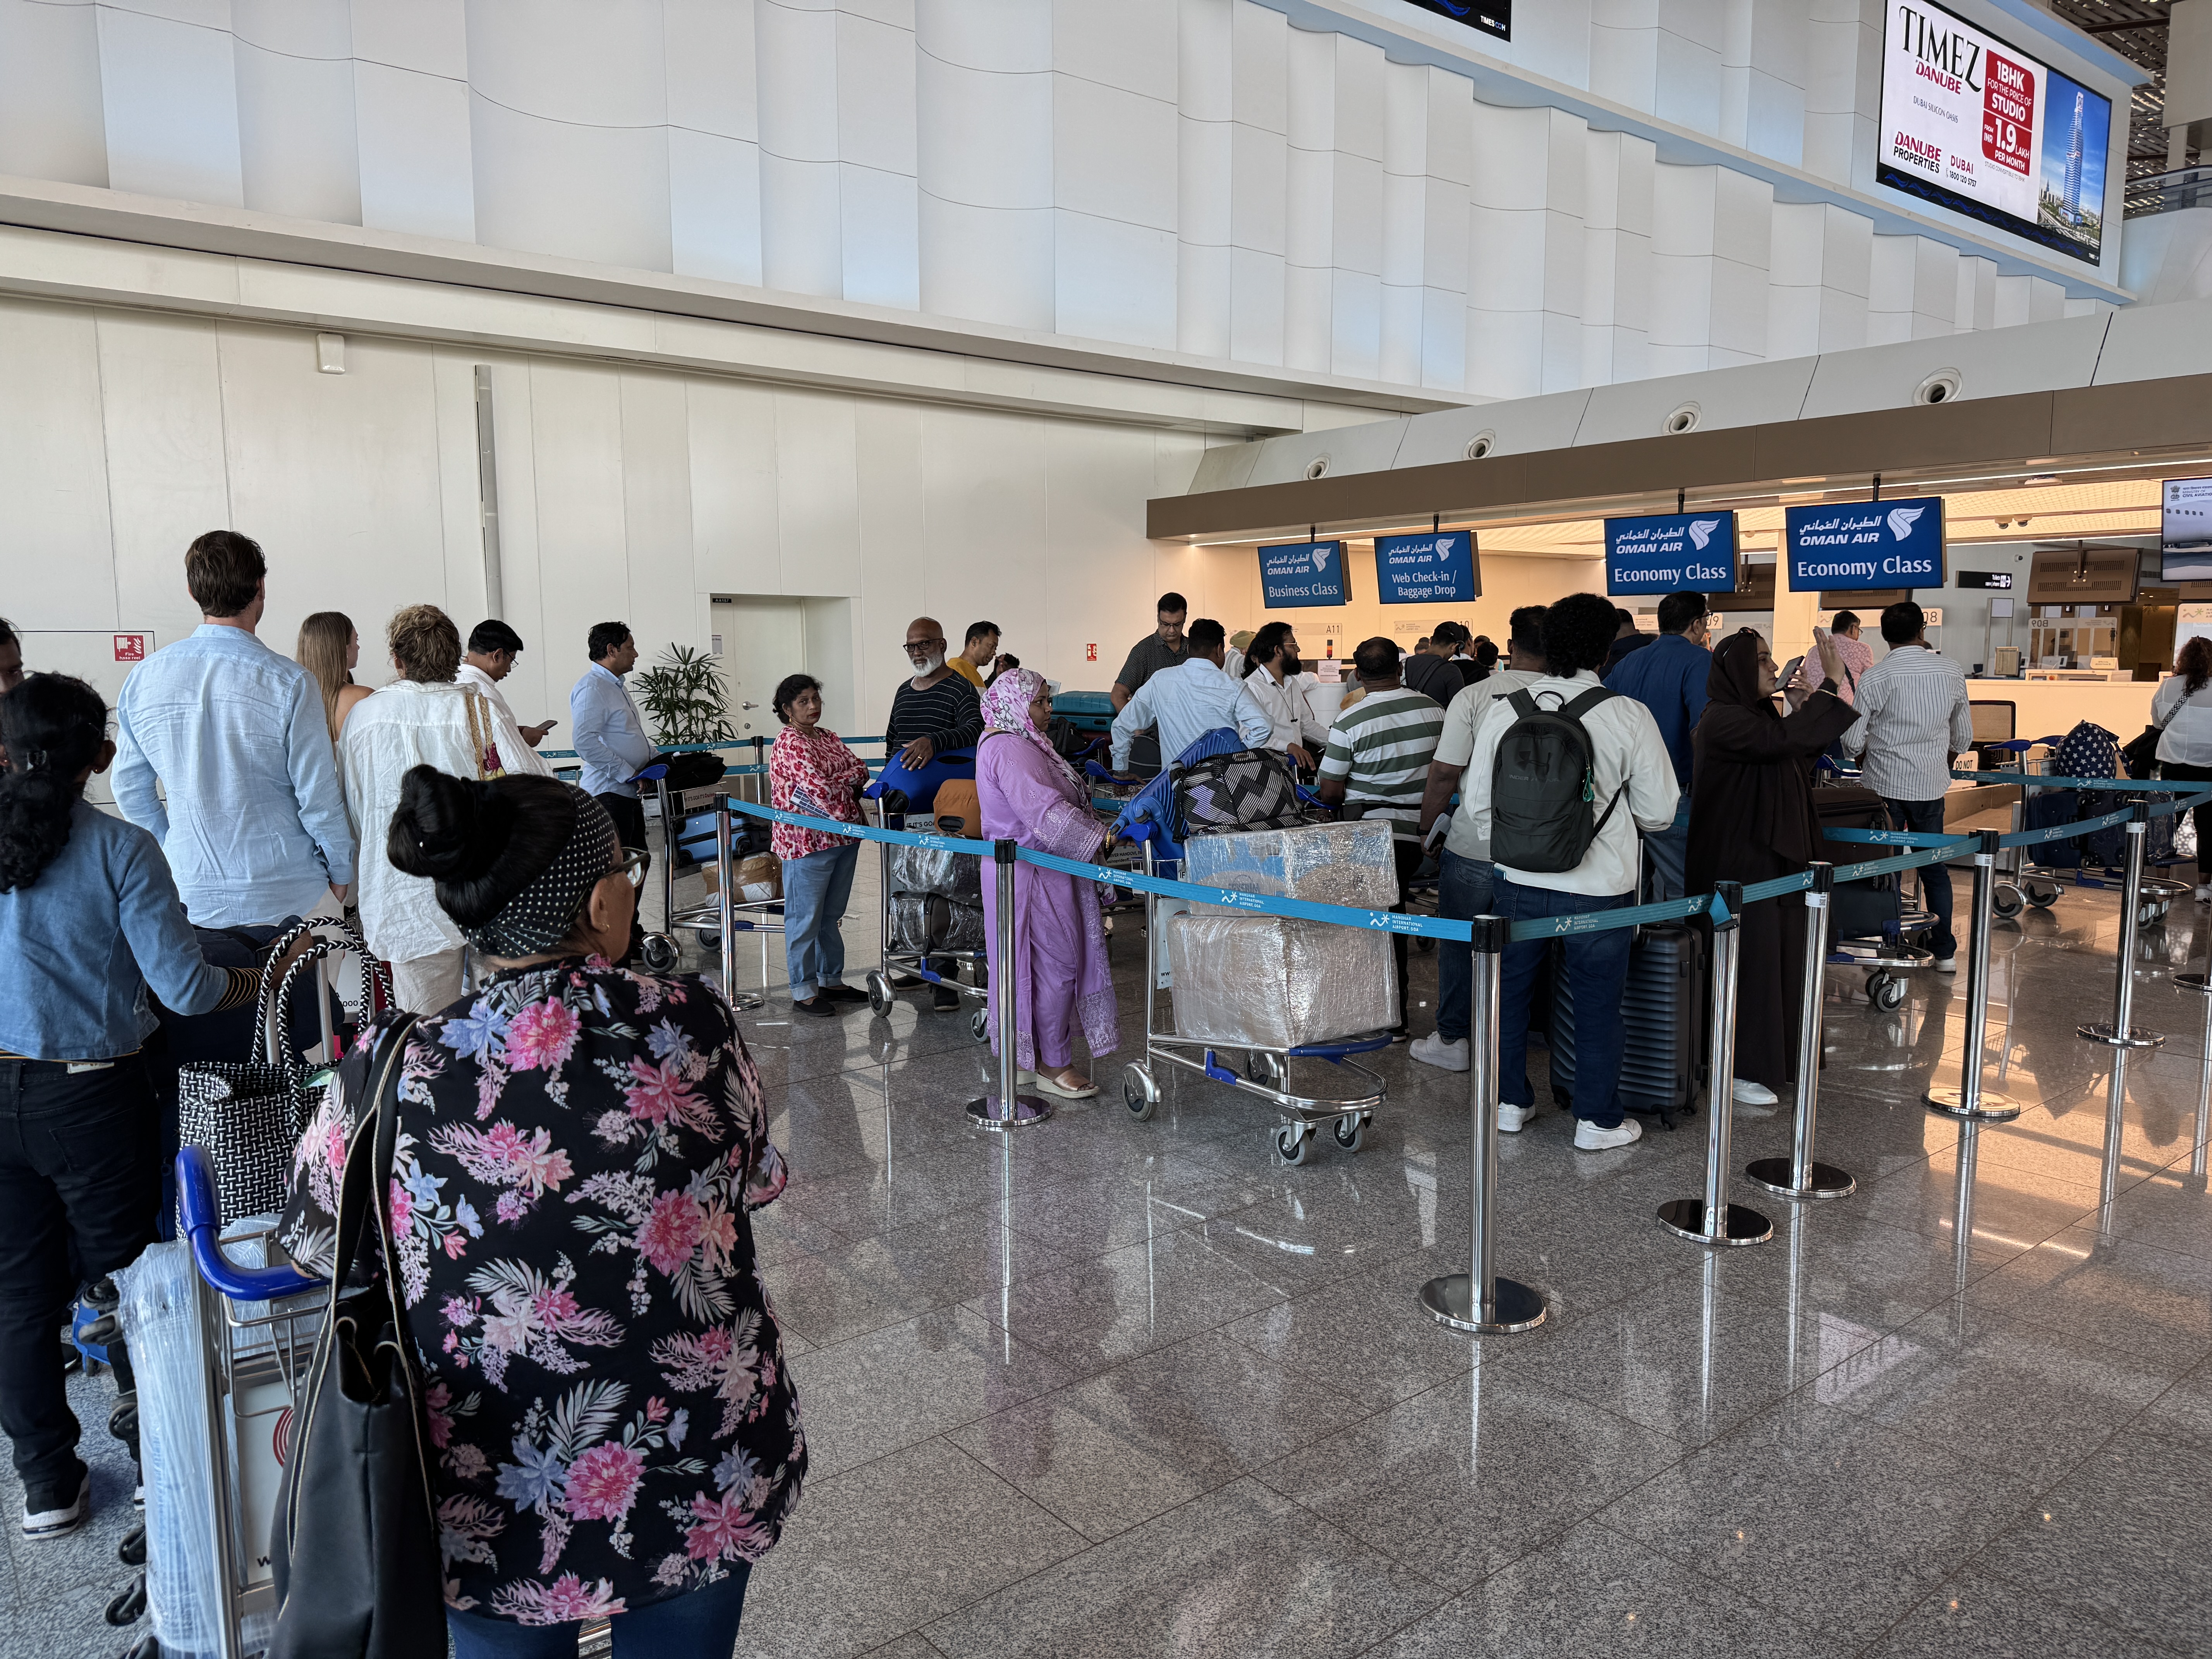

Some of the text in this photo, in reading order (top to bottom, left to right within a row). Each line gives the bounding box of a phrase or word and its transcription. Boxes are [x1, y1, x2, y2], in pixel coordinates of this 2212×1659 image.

[1480, 15, 1495, 27] TIMES
[1899, 6, 1982, 92] TIMEZ
[1916, 61, 1962, 94] DANUBE
[1997, 60, 2025, 92] 1BHK
[1987, 78, 2032, 107] FOR THE PRICE OF
[1913, 96, 1958, 123] DUBAI SILICON OASIS
[1992, 93, 2025, 122] STUDIO
[1984, 124, 1994, 133] FROM
[1996, 118, 2016, 153] 1.9
[1984, 132, 1993, 144] INR
[1895, 131, 1942, 162] DANUBE
[2015, 145, 2030, 160] LAKH
[1894, 146, 1940, 173] PROPERTIES
[1951, 155, 1973, 174] DUBAI
[1995, 150, 2025, 171] PER MONTH
[1949, 170, 1959, 180] 1800
[1968, 178, 1977, 187] 5757
[1841, 515, 1882, 531] الطيران
[1650, 527, 1685, 540] الطيران
[1800, 532, 1879, 546] OMAN AIR
[1411, 544, 1432, 553] الطيران
[1616, 542, 1683, 554] OMAN AIR
[1288, 553, 1309, 564] الطيران
[1267, 567, 1293, 575] OMAN
[1614, 563, 1726, 585] Economy Class
[1798, 555, 1932, 580] Economy Class
[1392, 570, 1456, 584] Web Check-in /
[1269, 582, 1338, 597] Business Class
[1398, 585, 1456, 598] Baggage Drop
[1922, 611, 1937, 622] 08
[1326, 625, 1339, 633] A11
[1956, 760, 1973, 769] DO NOT
